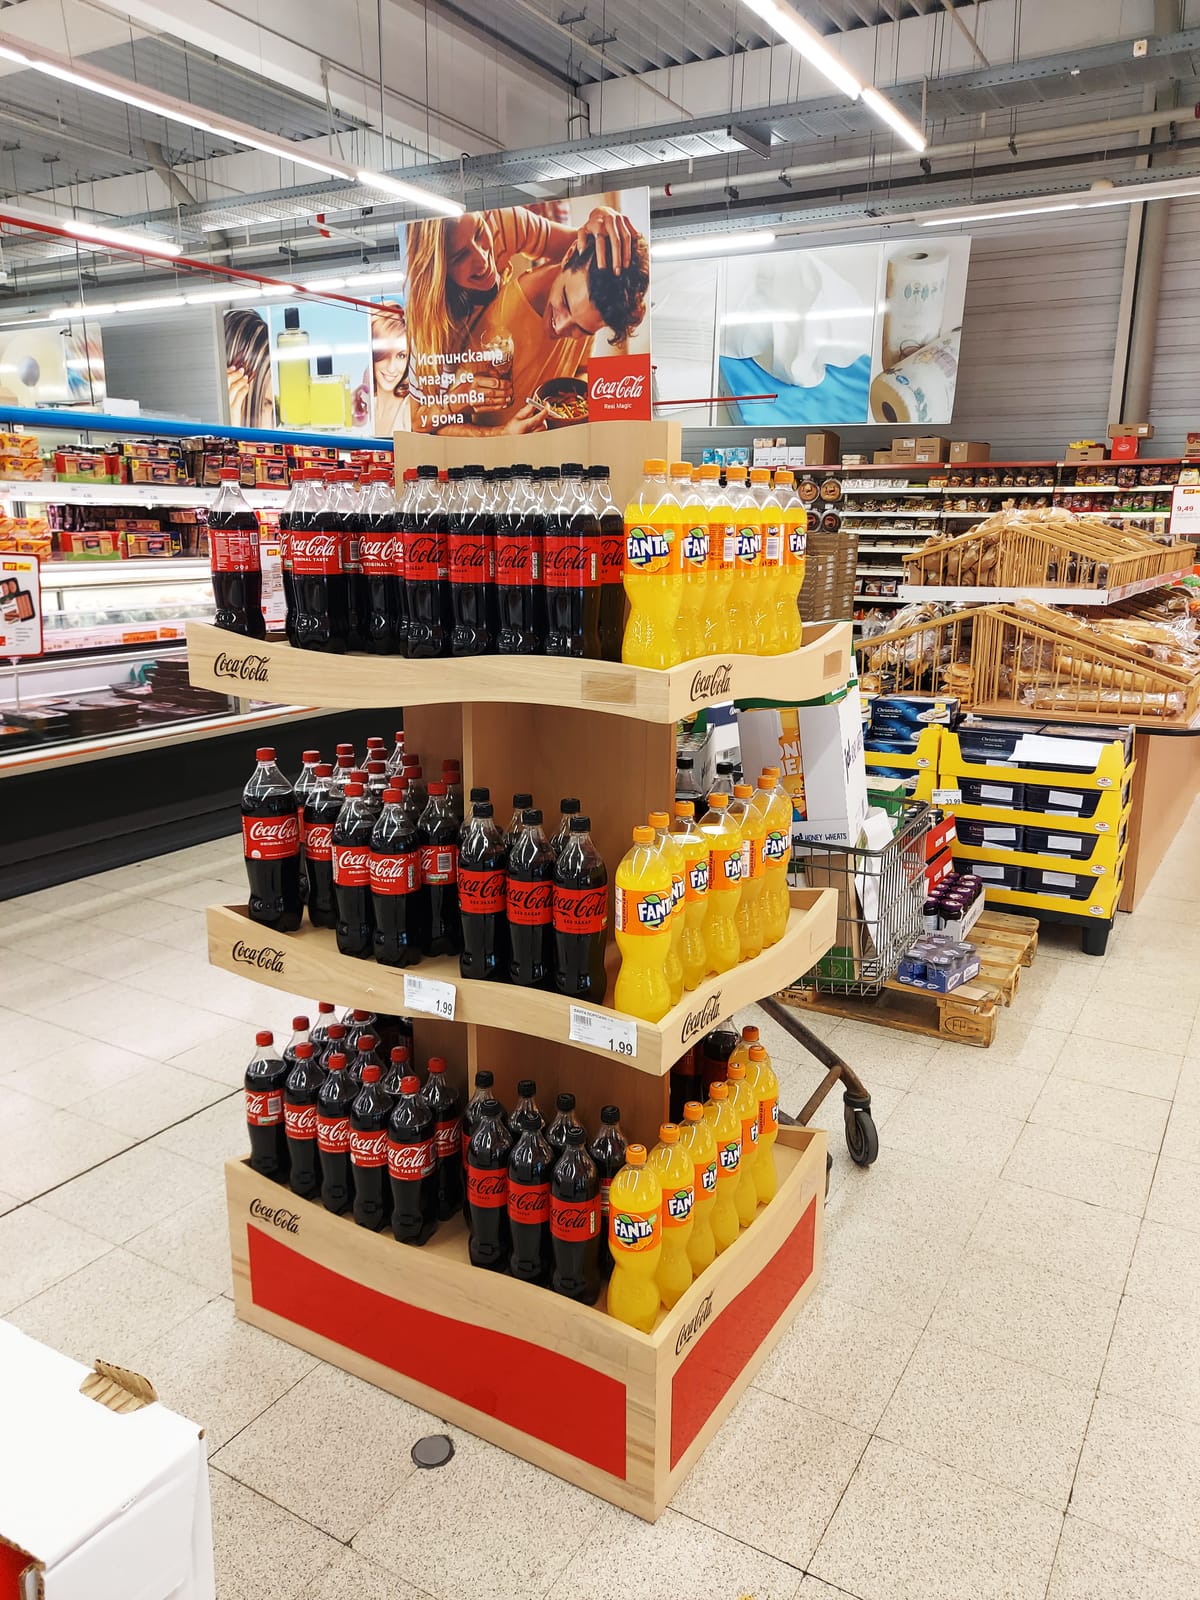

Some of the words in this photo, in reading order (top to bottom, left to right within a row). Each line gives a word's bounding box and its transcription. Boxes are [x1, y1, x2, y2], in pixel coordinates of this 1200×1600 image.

[417, 348, 503, 366] Истинската
[419, 374, 456, 386] магия
[460, 372, 474, 383] се
[591, 375, 646, 400] Coca-Cola
[420, 390, 484, 408] приготвя
[616, 401, 633, 410] Magic
[420, 415, 428, 427] у
[432, 413, 464, 427] дома
[627, 535, 669, 558] FANTA
[735, 534, 762, 554] FANT
[214, 652, 271, 682] Coca-Cola
[690, 663, 733, 702] Coca-Cola
[765, 836, 789, 855] FANT
[638, 897, 671, 921] FANT
[232, 940, 287, 974] Coca-Cola
[436, 999, 453, 1016] 1.99
[681, 989, 723, 1044] Coca-Cola
[608, 1038, 633, 1056] 1.99
[249, 1198, 302, 1235] Coca-Cola
[614, 1218, 652, 1238] FANTA
[675, 1288, 715, 1356] Coca-Cola
